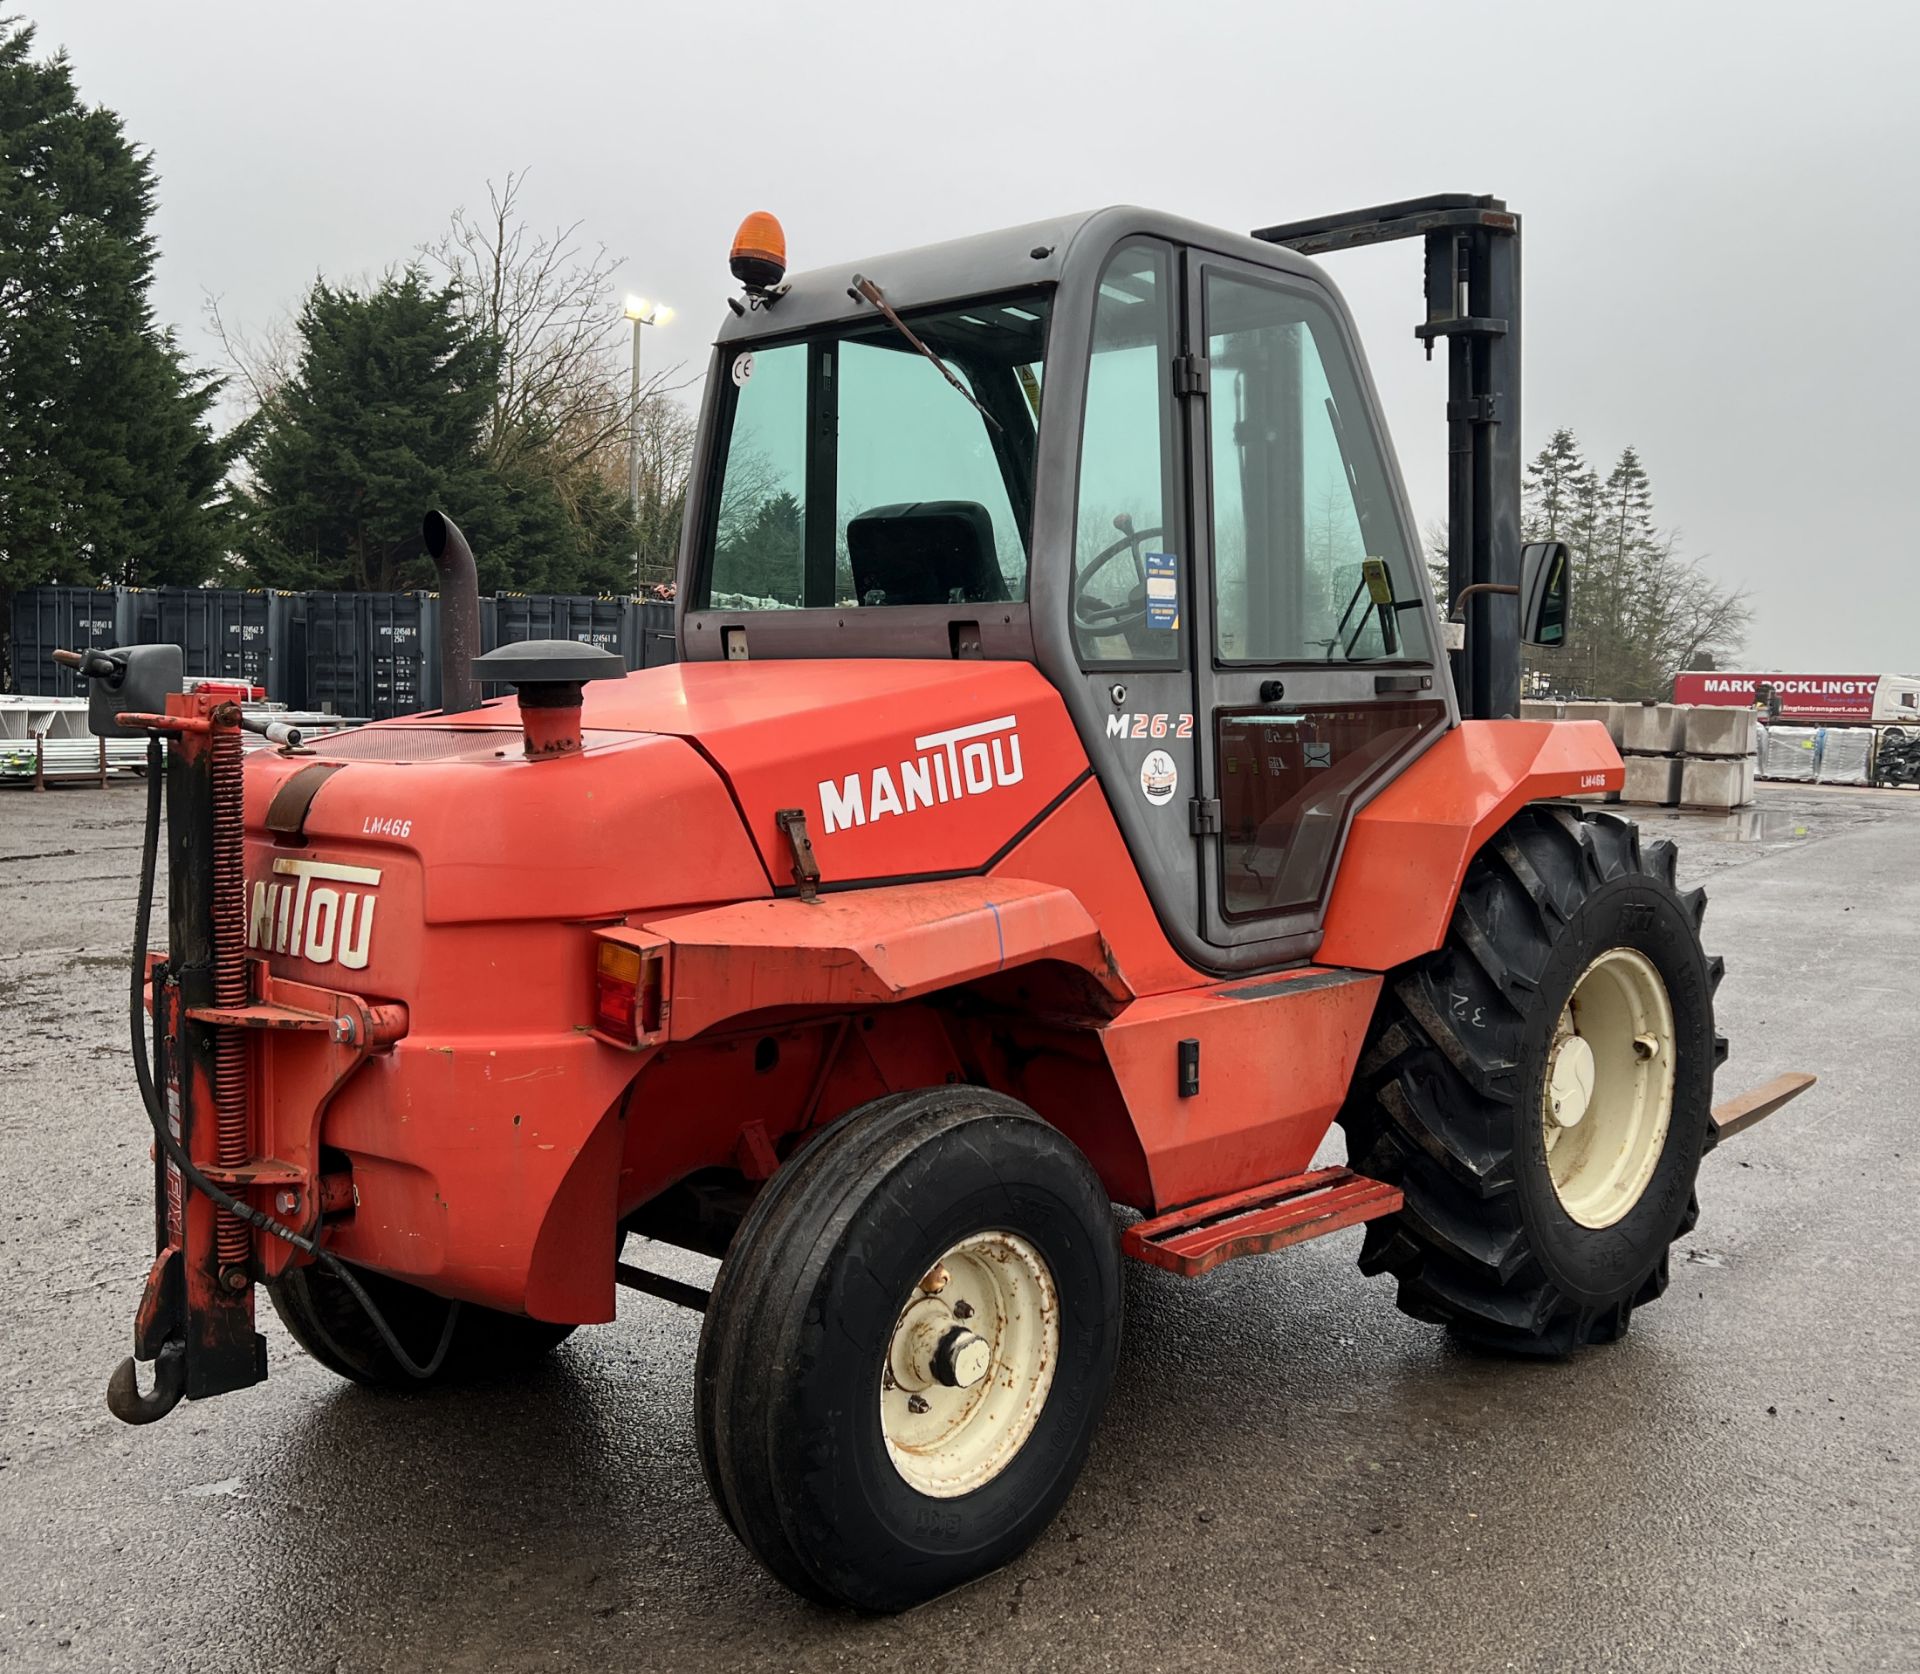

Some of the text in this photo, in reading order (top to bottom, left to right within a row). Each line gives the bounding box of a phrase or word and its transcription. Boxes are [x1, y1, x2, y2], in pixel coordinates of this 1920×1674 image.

[1704, 680, 1755, 692] MARK
[818, 714, 1023, 834] MANITOU
[1581, 774, 1606, 788] LM466
[363, 817, 412, 838] LM466
[243, 858, 382, 969] NITOU
